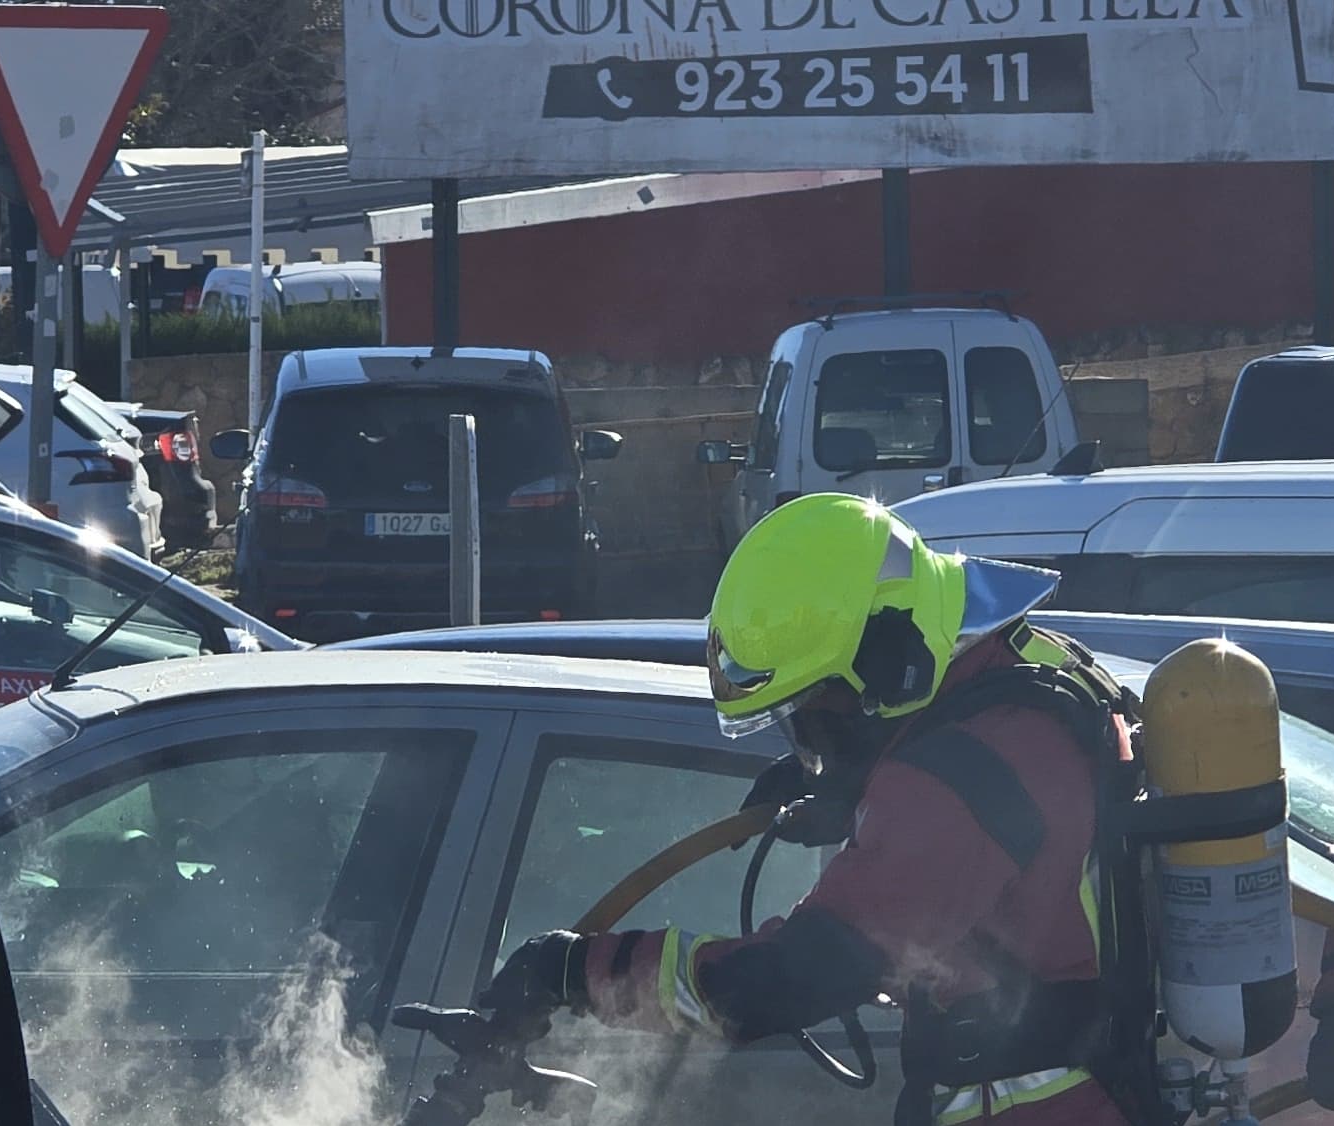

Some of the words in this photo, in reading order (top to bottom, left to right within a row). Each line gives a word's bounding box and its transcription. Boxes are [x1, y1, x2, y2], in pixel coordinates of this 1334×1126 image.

[675, 59, 783, 112] 923
[803, 57, 874, 109] 25
[895, 54, 968, 106] 54
[986, 52, 1030, 103] 11
[381, 515, 424, 533] 1027
[429, 515, 452, 533] GJ
